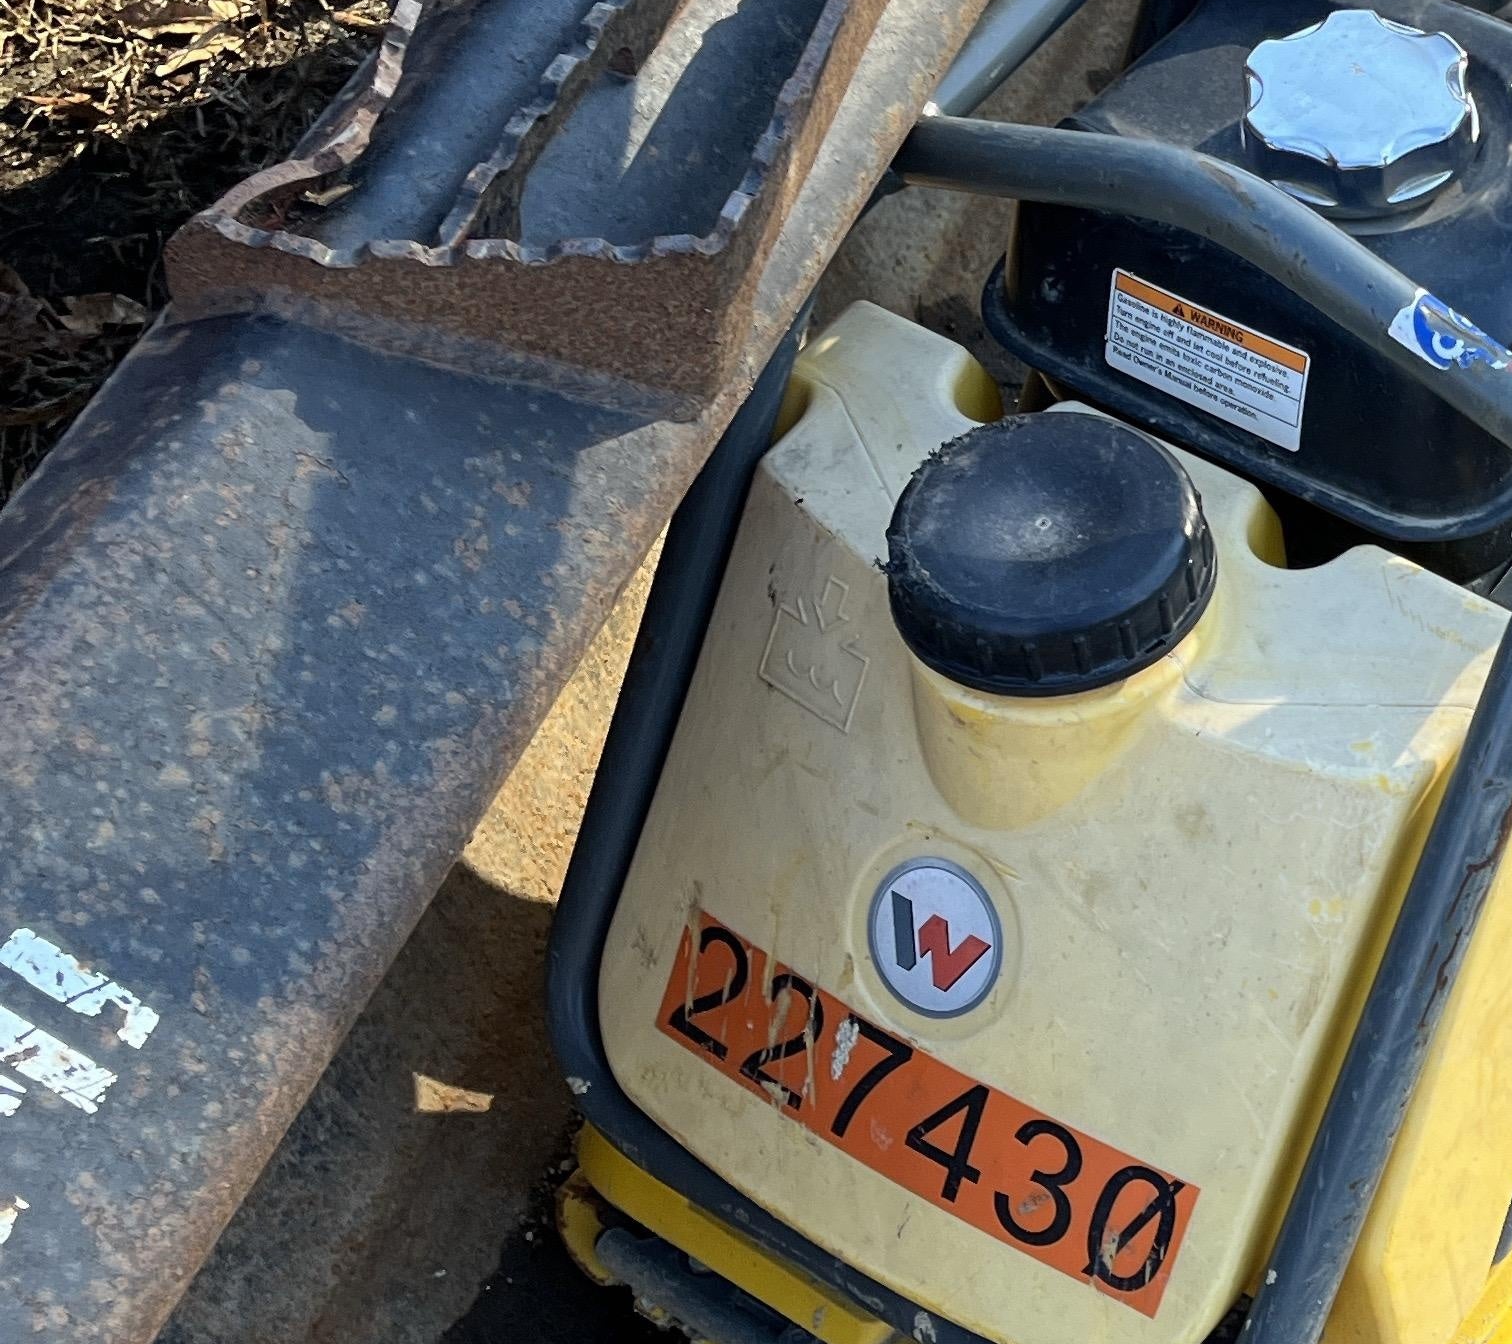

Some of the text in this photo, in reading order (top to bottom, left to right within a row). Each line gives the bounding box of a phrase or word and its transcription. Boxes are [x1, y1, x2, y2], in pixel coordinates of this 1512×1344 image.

[1115, 319, 1129, 334] The
[1130, 329, 1157, 346] engine
[1158, 342, 1180, 358] emits
[1182, 351, 1202, 368] toxic
[1203, 364, 1233, 382] carbon
[1116, 304, 1133, 319] Turn
[1134, 316, 1161, 334] engine
[1162, 329, 1175, 339] off
[1176, 335, 1191, 347] and
[1205, 349, 1224, 362] cool
[1225, 357, 1252, 375] before
[1117, 292, 1150, 315] Gasoline
[1151, 311, 1159, 319] is
[1160, 313, 1185, 332] highly
[1186, 325, 1230, 352] flammable
[1231, 347, 1248, 360] and
[1190, 309, 1244, 343] WARNING
[1112, 344, 1132, 360] Read
[1164, 369, 1192, 390] Manual
[1193, 383, 1218, 401] before
[1113, 331, 1125, 344] Do
[1126, 339, 1139, 350] not
[1140, 346, 1154, 357] run
[1155, 353, 1163, 362] in
[1165, 358, 1176, 367] an
[1177, 364, 1213, 385] enclosed
[668, 926, 1186, 1292] 227430
